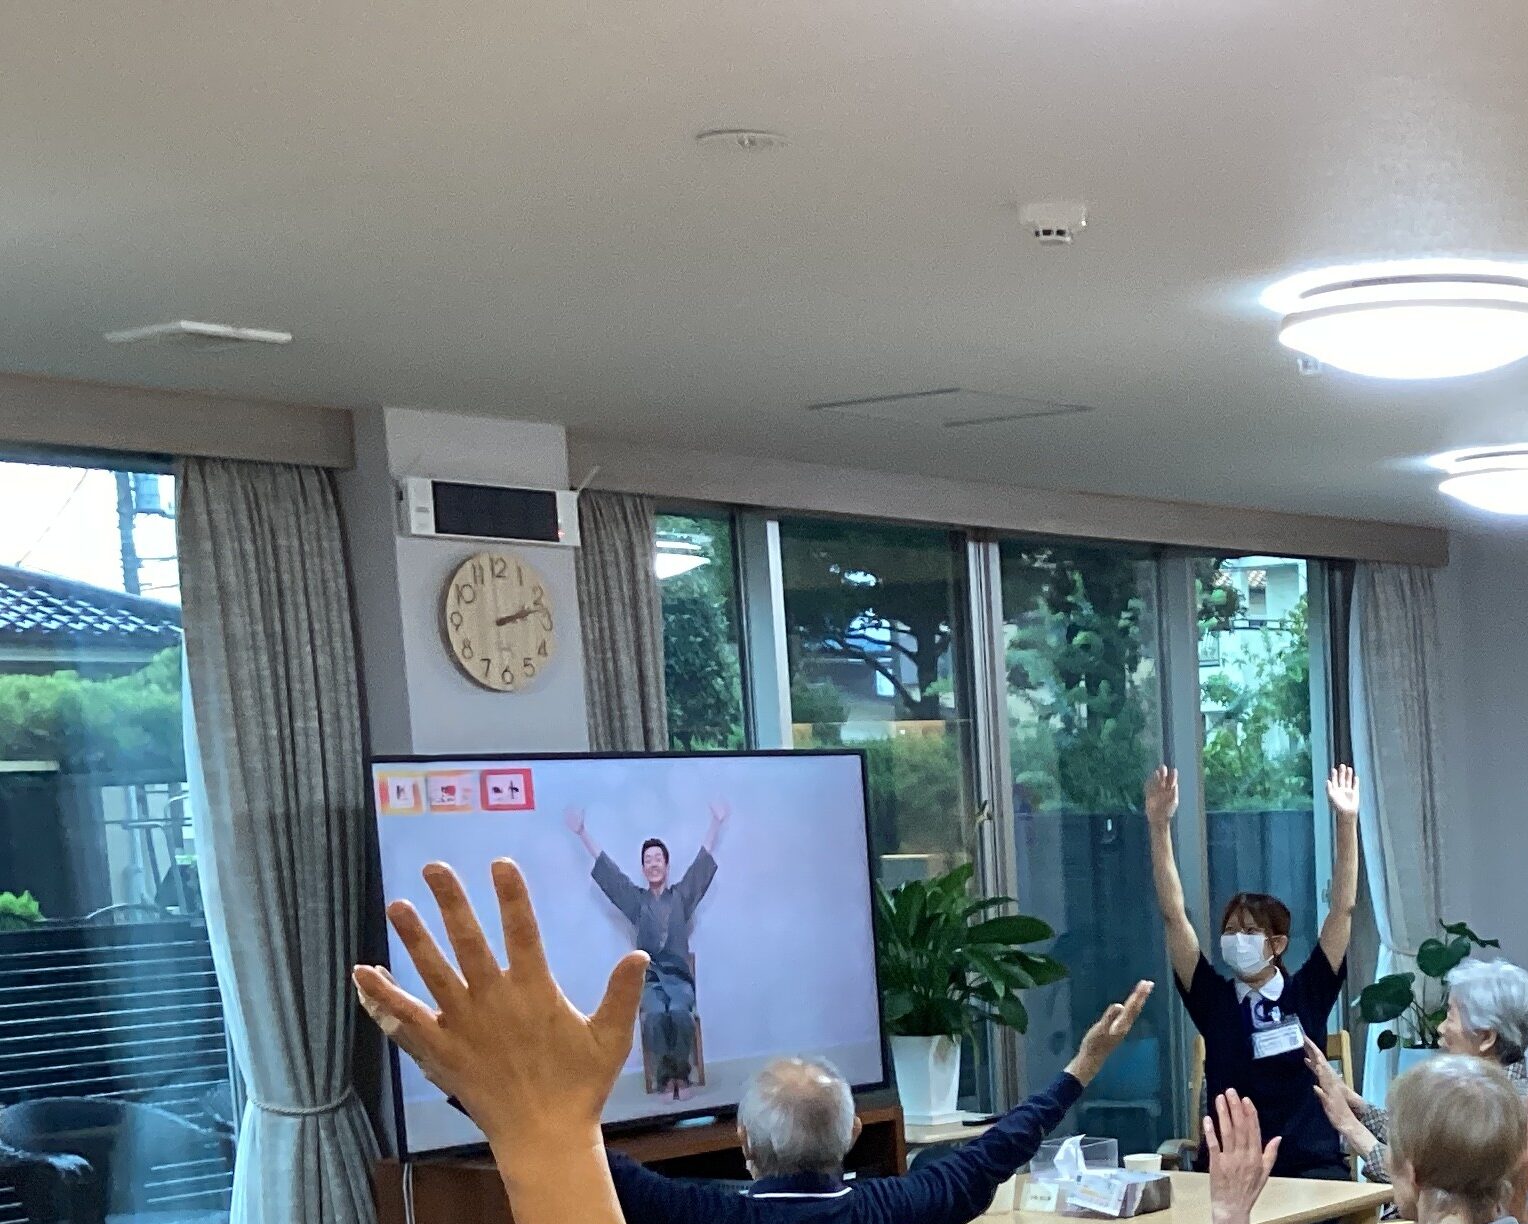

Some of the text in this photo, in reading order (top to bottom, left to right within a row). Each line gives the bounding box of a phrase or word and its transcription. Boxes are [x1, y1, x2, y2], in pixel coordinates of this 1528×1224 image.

[471, 563, 485, 585] 11
[488, 557, 506, 578] 12
[516, 565, 523, 586] 1
[454, 583, 476, 604] 10
[532, 585, 545, 606] 2
[450, 611, 463, 631] 9
[461, 638, 474, 660] 8
[537, 640, 549, 658] 4
[480, 658, 491, 678] 7
[501, 666, 515, 685] 6
[522, 657, 536, 678] 5
